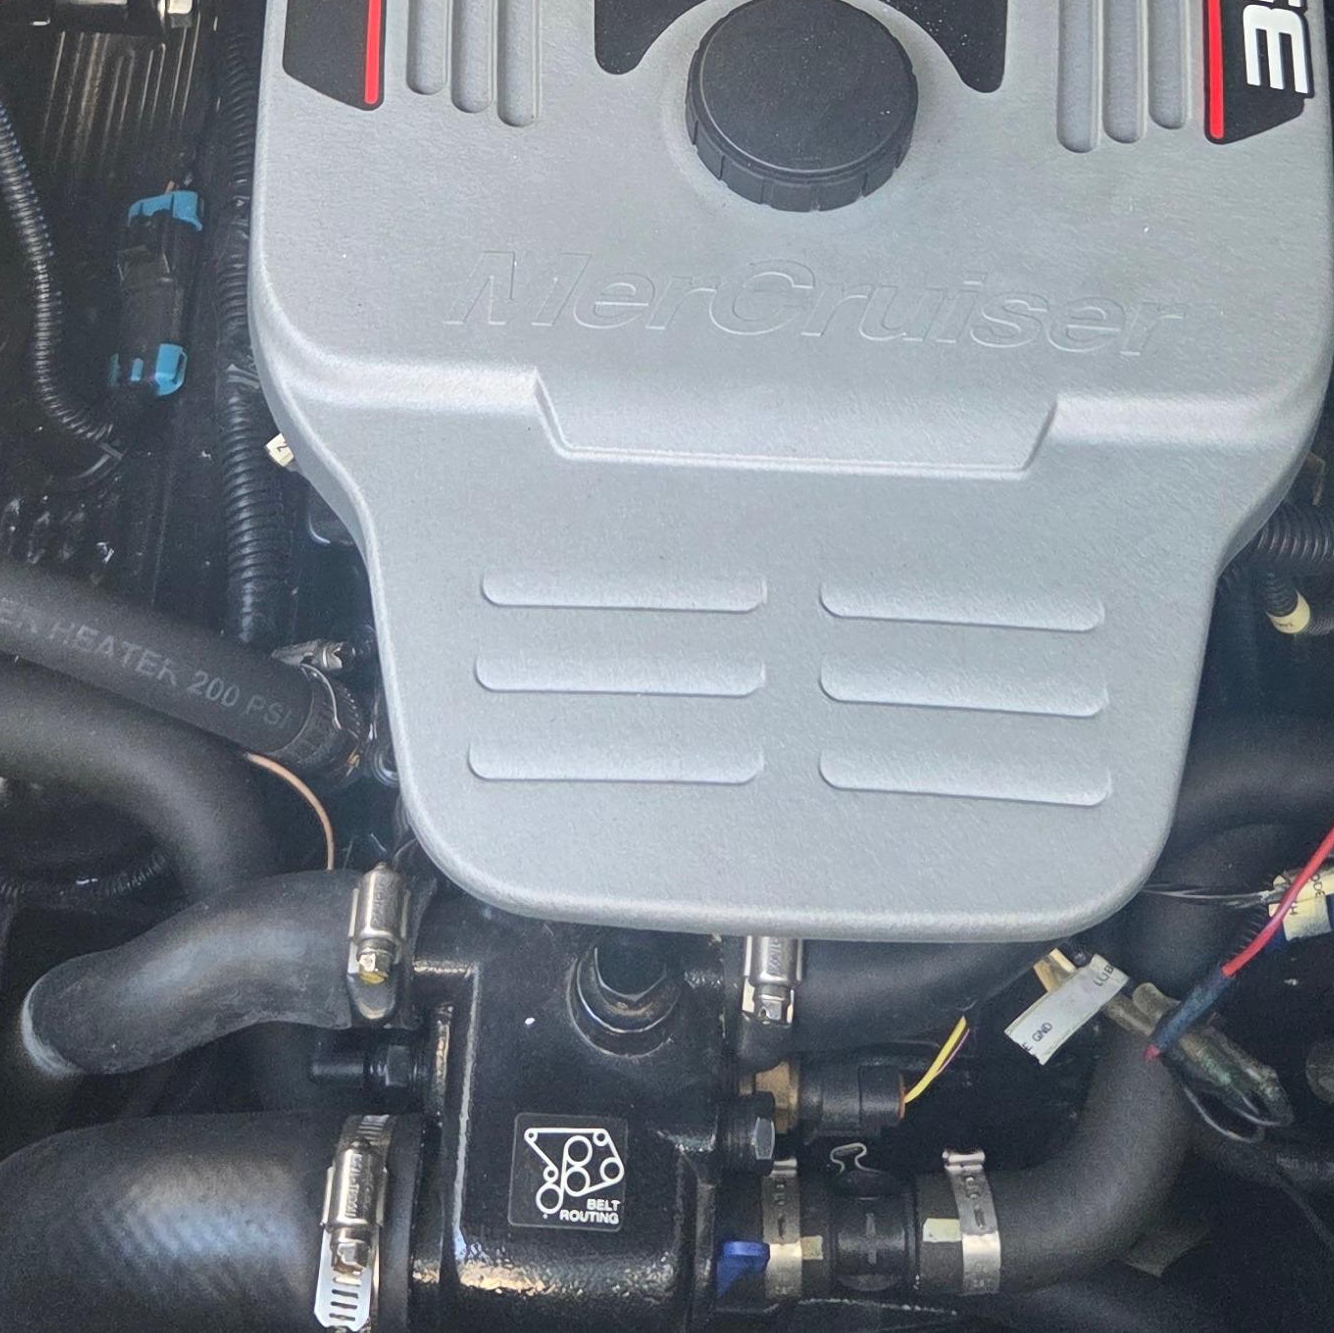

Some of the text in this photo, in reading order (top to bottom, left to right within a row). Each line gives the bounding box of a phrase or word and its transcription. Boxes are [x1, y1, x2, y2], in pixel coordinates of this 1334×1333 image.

[442, 251, 1185, 356] MerCruiser
[49, 620, 179, 688] HEATER
[187, 669, 242, 710] 200
[245, 693, 293, 731] PSI
[1032, 1021, 1054, 1044] GND
[586, 1198, 623, 1212] BELT
[559, 1209, 620, 1226] ROUTING
